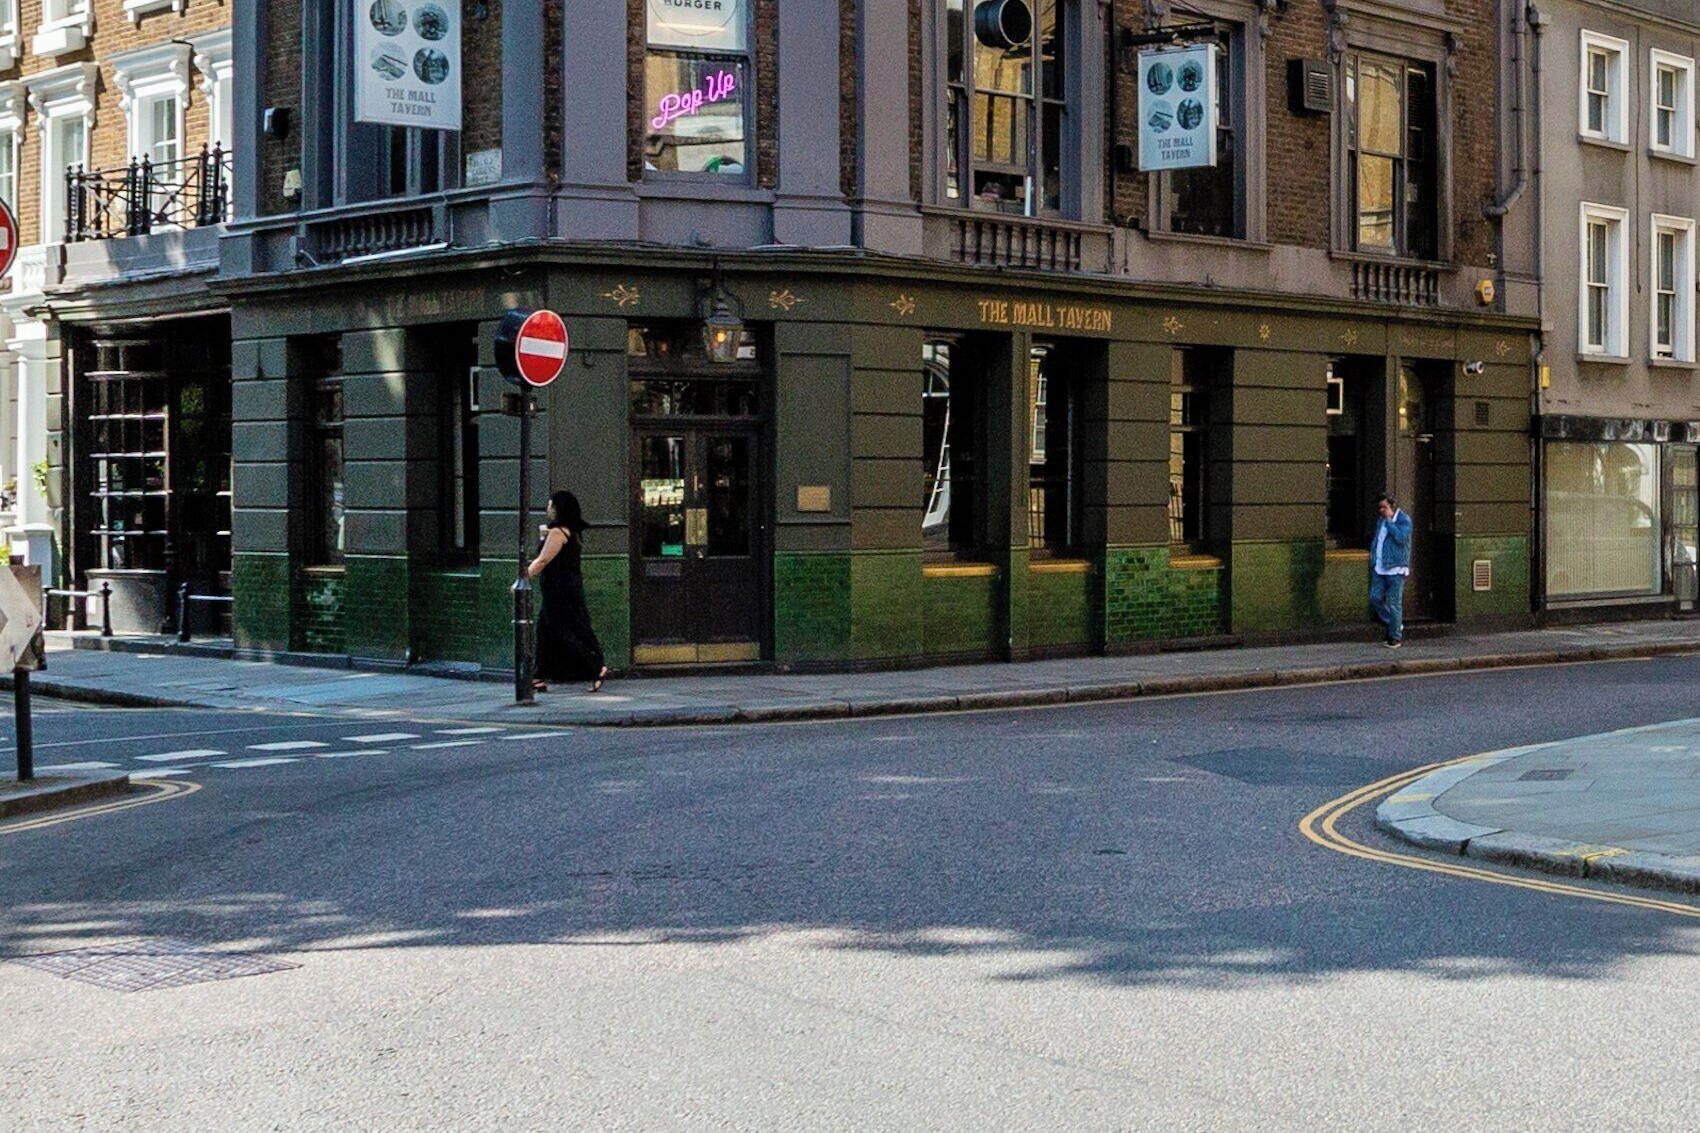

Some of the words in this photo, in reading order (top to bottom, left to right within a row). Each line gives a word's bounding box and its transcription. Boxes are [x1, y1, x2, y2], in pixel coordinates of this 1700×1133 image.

[385, 87, 405, 101] THE
[408, 90, 437, 103] MALL
[652, 89, 703, 129] Pop
[705, 69, 735, 102] Up
[390, 102, 432, 116] TAVERN
[1157, 137, 1171, 149] THE
[1173, 136, 1194, 147] MALL
[1161, 149, 1191, 160] TAVERN
[978, 298, 1008, 324] THE
[1012, 301, 1054, 327] MALL
[1056, 306, 1112, 332] TAVERN
